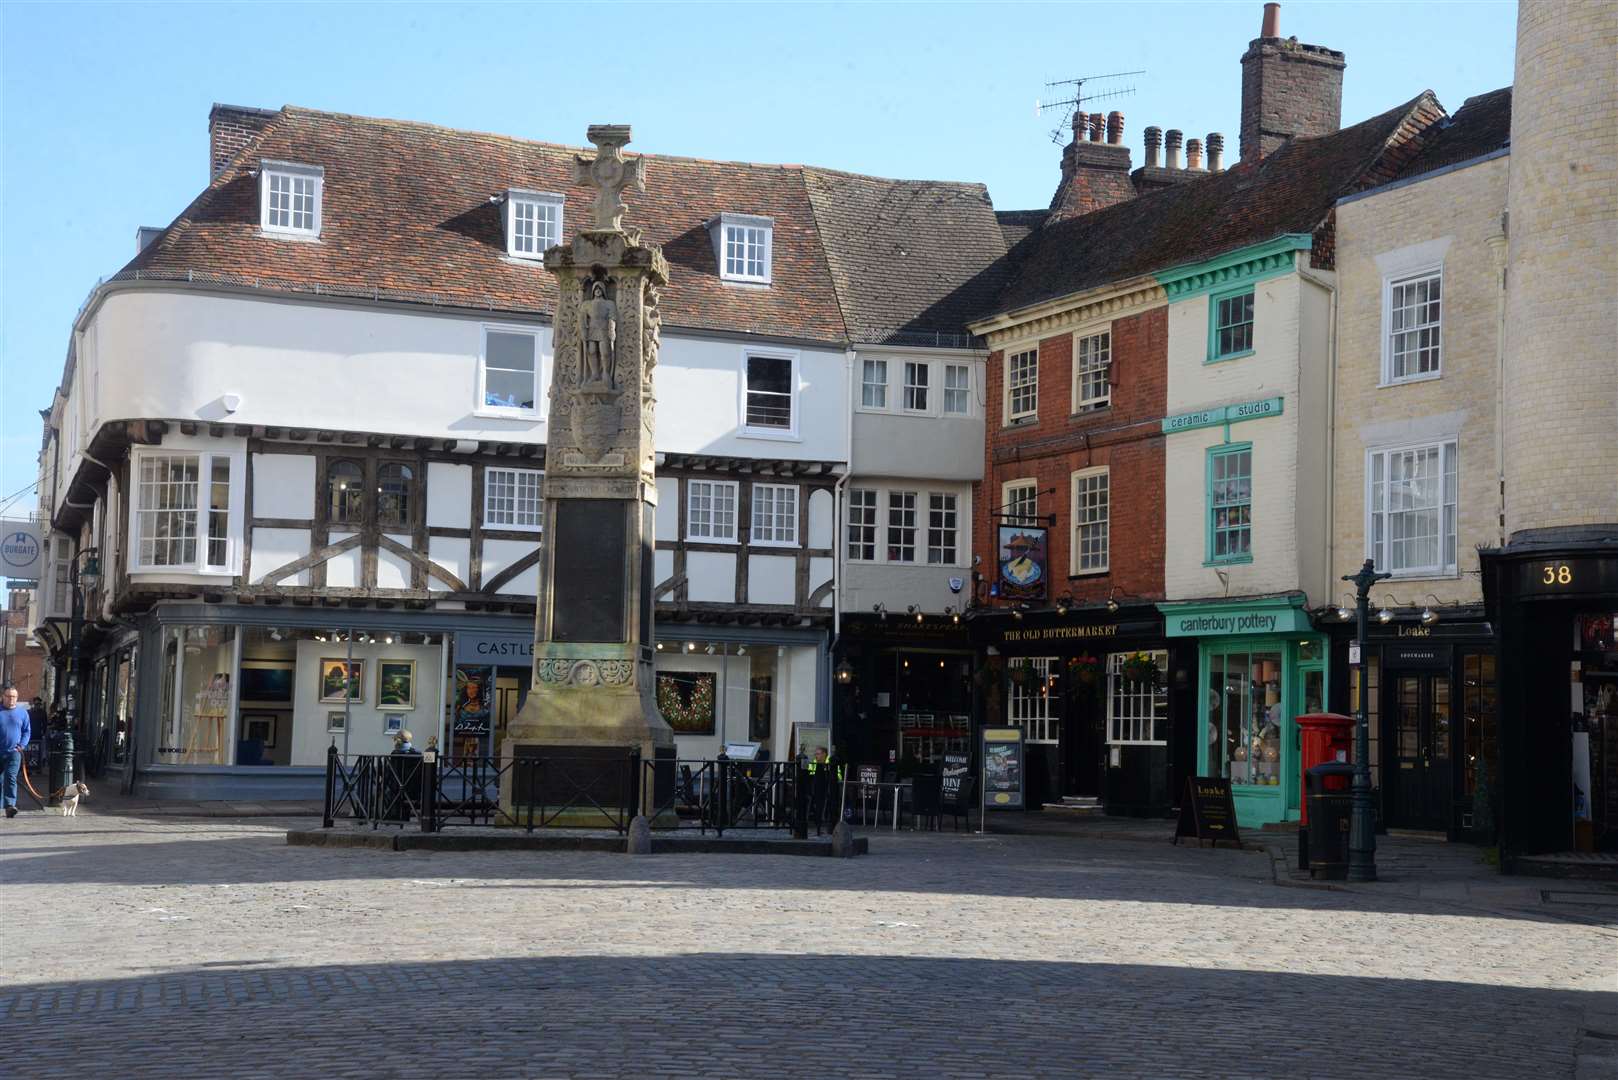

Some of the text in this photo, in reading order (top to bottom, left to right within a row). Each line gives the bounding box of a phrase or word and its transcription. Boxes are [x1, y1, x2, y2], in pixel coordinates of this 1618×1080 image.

[1171, 402, 1271, 428] ceramic studio
[4, 544, 35, 555] BURGATE
[1543, 565, 1572, 584] 38
[1180, 613, 1277, 633] canterbury pottery
[1398, 624, 1431, 637] Loake
[1004, 625, 1118, 641] THE OLD BUTTERMARKET
[476, 642, 535, 656] CASTLE
